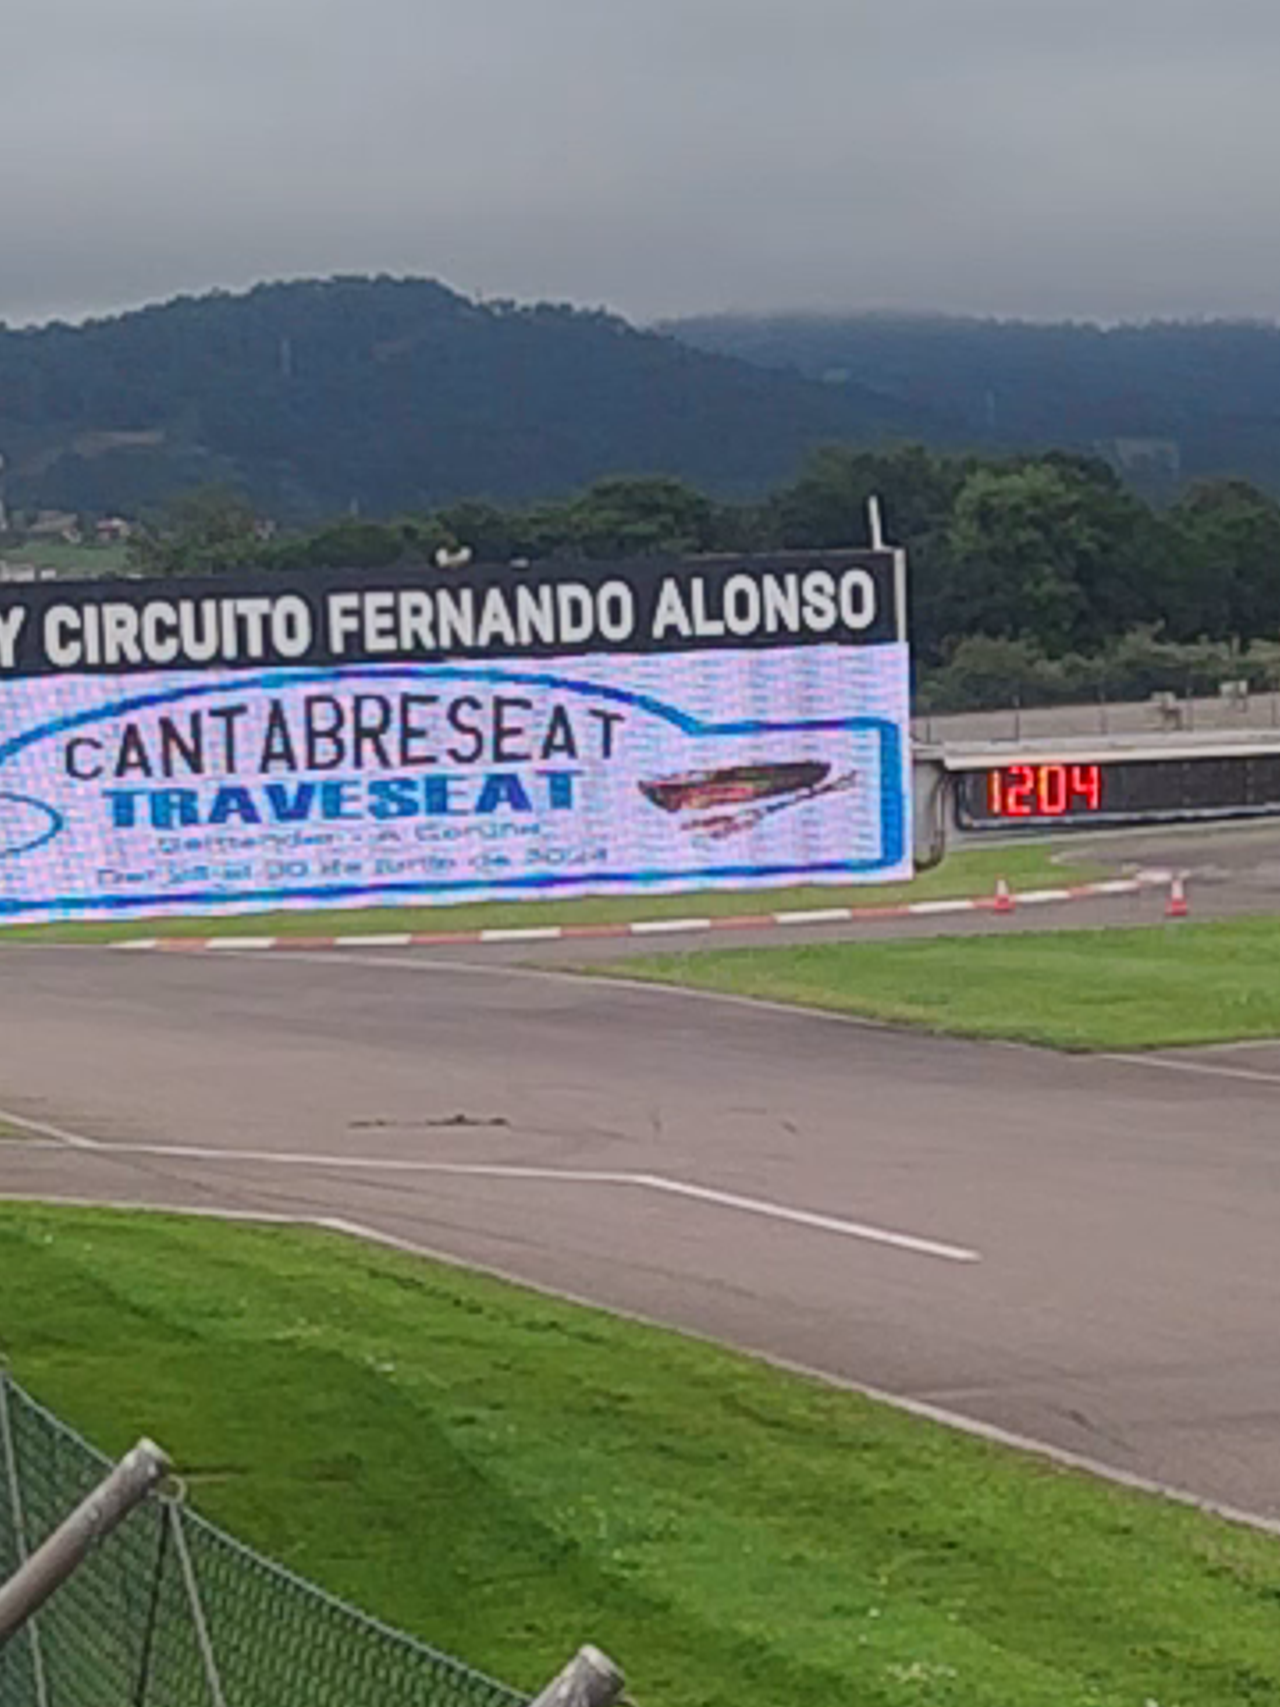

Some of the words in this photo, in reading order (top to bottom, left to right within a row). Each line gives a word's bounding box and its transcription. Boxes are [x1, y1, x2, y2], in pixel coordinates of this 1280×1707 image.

[43, 595, 312, 666] CIRCUITO
[328, 581, 635, 654] FERNANDO
[651, 569, 876, 639] ALONSO
[64, 693, 625, 781] CANTABRESEAT
[101, 769, 584, 830] TRAVESEAT
[991, 764, 1100, 814] 1204
